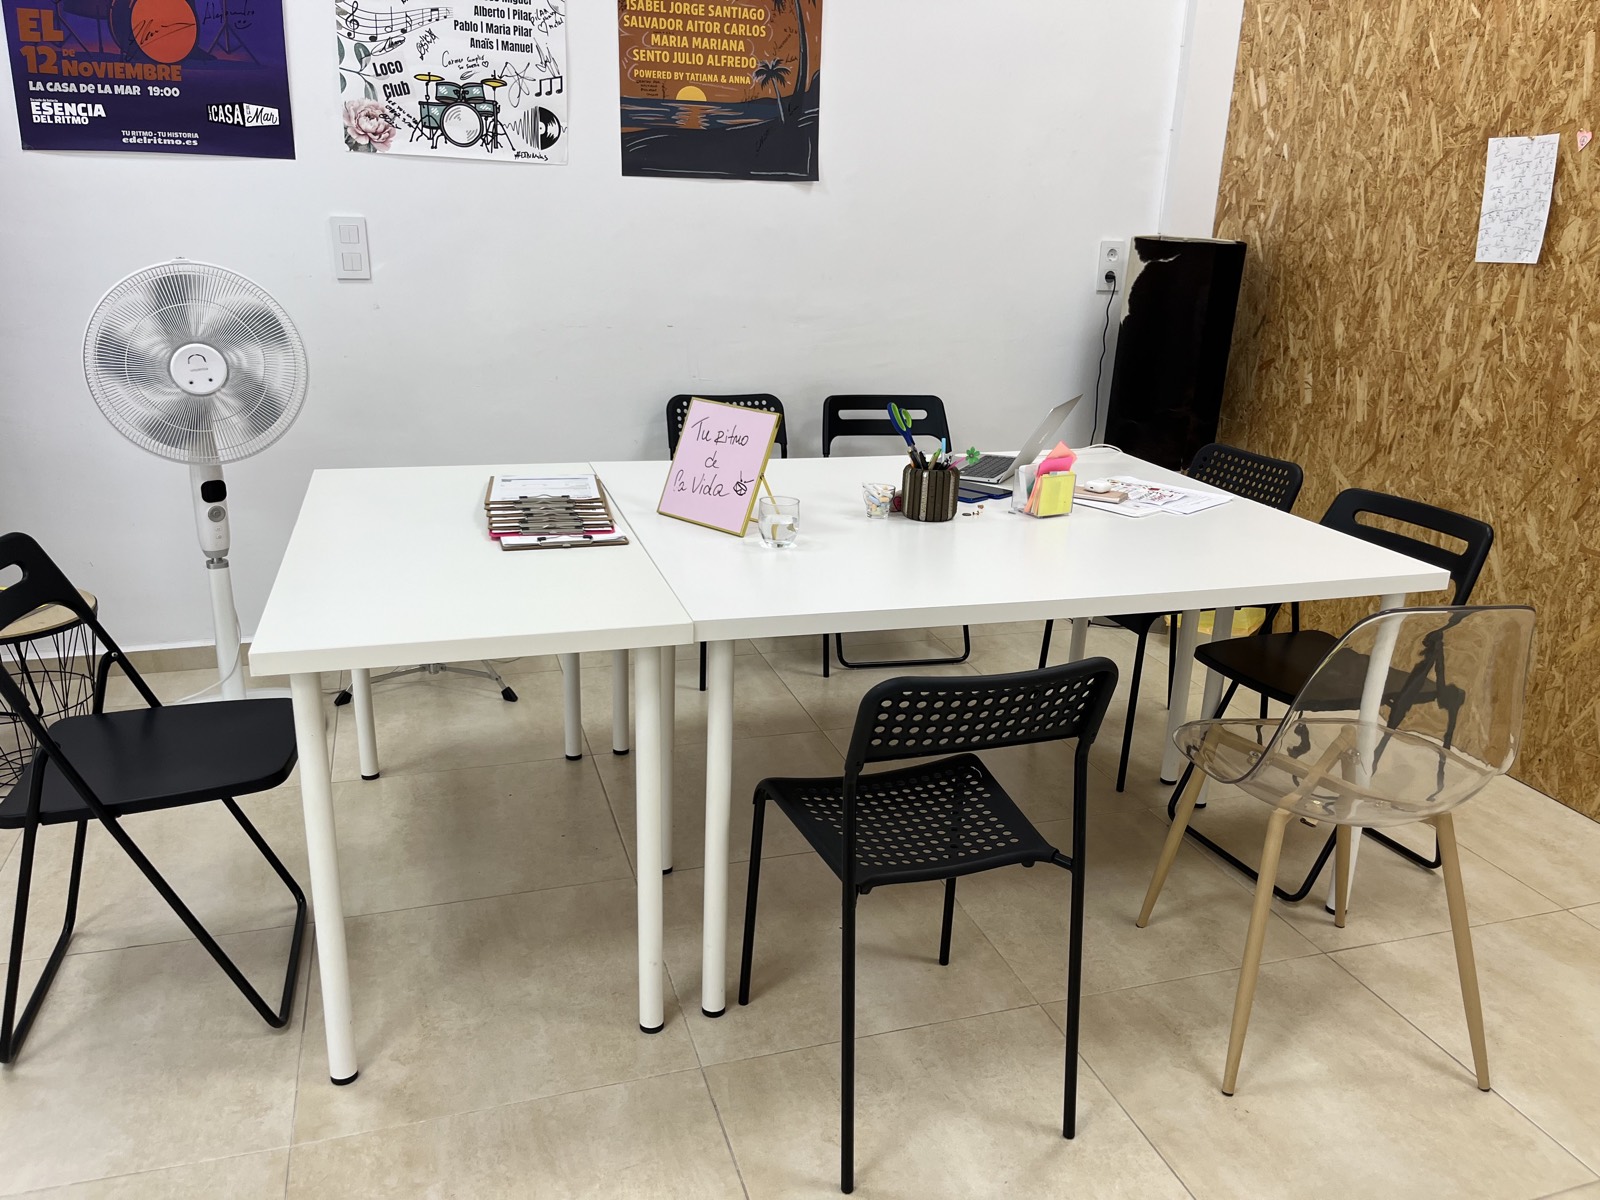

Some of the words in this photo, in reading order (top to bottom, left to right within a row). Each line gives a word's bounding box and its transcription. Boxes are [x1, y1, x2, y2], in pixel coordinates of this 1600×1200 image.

[474, 5, 506, 19] Alberto
[512, 9, 532, 21] Pilar
[626, 0, 666, 13] ISABEL
[669, 1, 705, 16] JORGE
[708, 4, 765, 21] SANTIAGO
[16, 8, 64, 42] EL
[453, 20, 478, 32] Pablo
[486, 22, 511, 36] Maria
[513, 25, 532, 37] Pilar
[623, 14, 683, 31] SALVADOR
[686, 20, 720, 34] AITOR
[724, 23, 766, 37] CARLOS
[470, 37, 494, 50] Anaïs
[501, 40, 533, 53] Manuel
[651, 33, 689, 48] MARIA
[692, 37, 745, 52] MARIANA
[20, 45, 58, 75] 12
[632, 48, 670, 63] SENTO
[672, 52, 704, 65] JULIO
[706, 54, 757, 69] ALFREDO
[62, 60, 182, 82] NOVIEMBRE
[633, 69, 672, 80] POWERED
[673, 72, 684, 80] BY
[685, 72, 718, 83] TATIANA
[720, 75, 727, 83] &
[729, 75, 751, 85] ANNA
[28, 81, 45, 92] LA
[46, 82, 78, 93] CASA
[97, 84, 112, 95] LA
[114, 85, 141, 96] MAR
[147, 86, 180, 97] 19:00
[383, 81, 411, 99] Club
[31, 101, 106, 117] ESENCIA
[211, 104, 244, 125] CASA
[247, 107, 278, 125] Mar
[32, 114, 53, 123] DEL
[54, 115, 89, 125] RITMO
[122, 136, 198, 146] edelritmo.es
[691, 416, 711, 442] Tu
[704, 451, 719, 469] de
[691, 473, 730, 497] Vida
